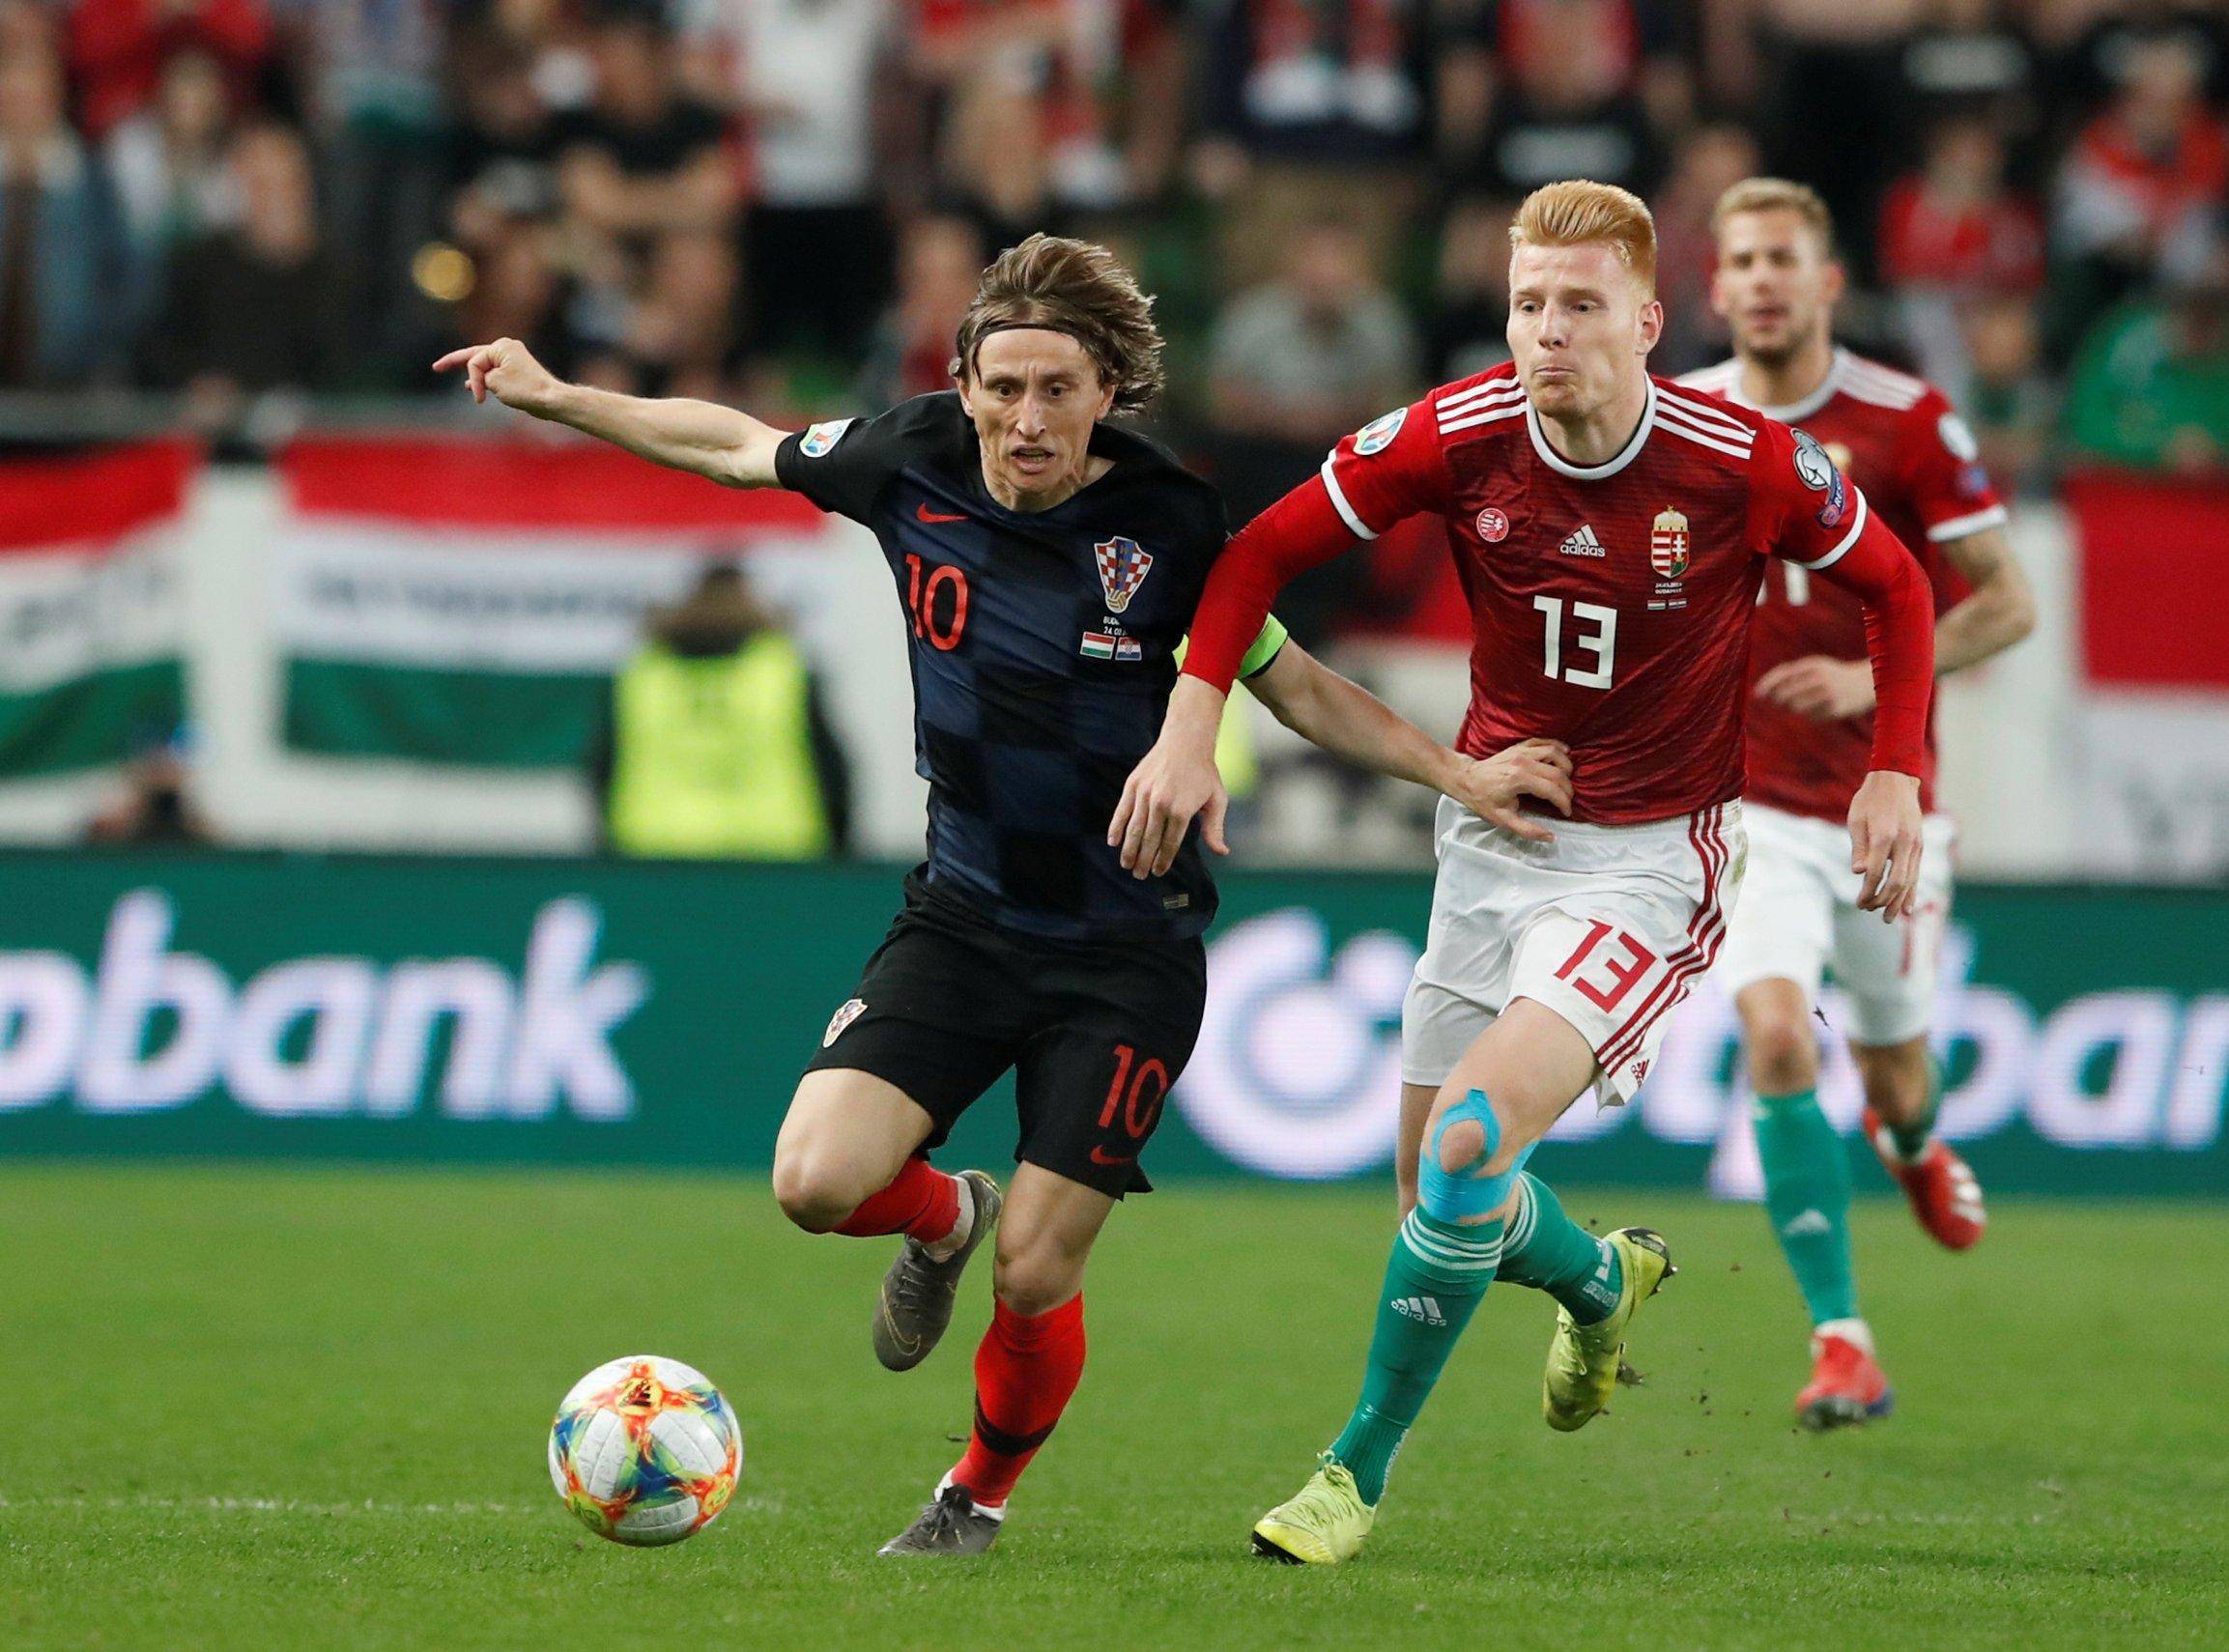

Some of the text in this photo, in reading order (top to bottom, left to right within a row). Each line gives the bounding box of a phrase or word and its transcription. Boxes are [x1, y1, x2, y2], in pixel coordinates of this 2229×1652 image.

[1559, 543, 1606, 557] adidas
[905, 553, 968, 651] 10
[1532, 594, 1618, 690] 13
[1553, 917, 1657, 1014] 13
[1099, 1043, 1168, 1138] 10
[1390, 1299, 1447, 1327] adidas
